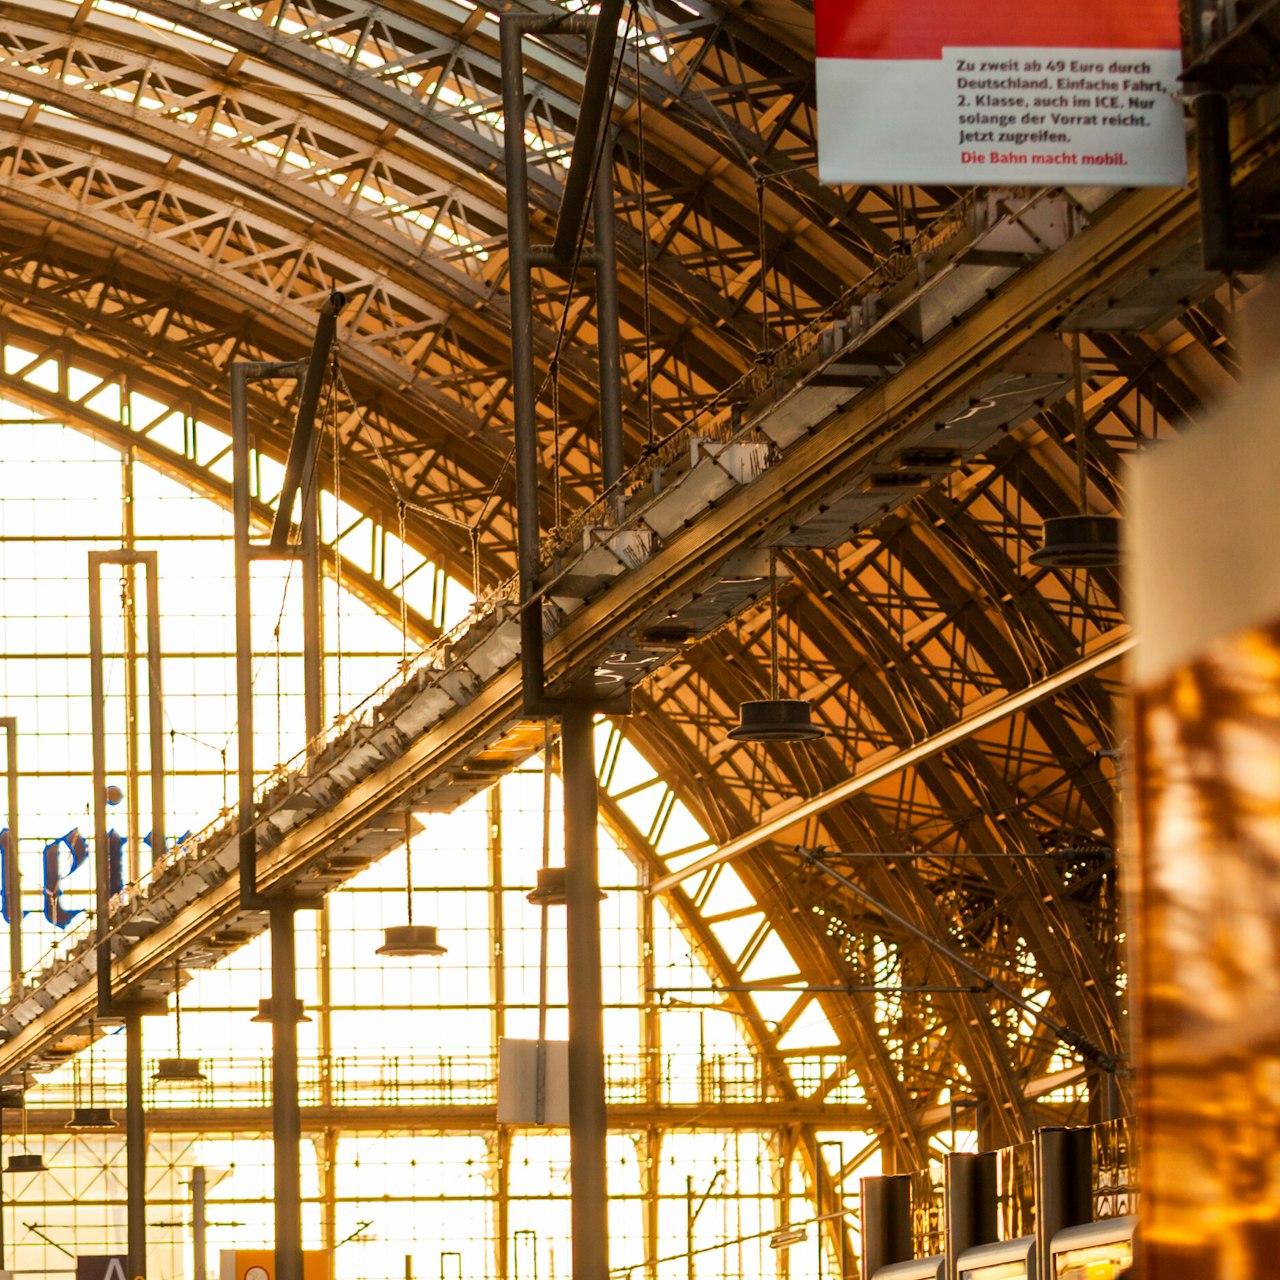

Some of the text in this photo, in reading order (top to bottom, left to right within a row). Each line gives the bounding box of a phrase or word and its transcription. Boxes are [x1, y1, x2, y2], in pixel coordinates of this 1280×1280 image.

[957, 60, 1151, 74] Zu zweit ab 49 Euro durch
[958, 78, 1167, 94] Deutschland. Einfache Fahrt,
[958, 95, 1155, 110] 2. Klasse, auch im ICE. Nur
[959, 112, 1151, 127] solange der Vorrat reicht.
[958, 130, 1071, 146] Jetzt zugreifen.
[961, 151, 1128, 166] Die Bahn macht mobil.
